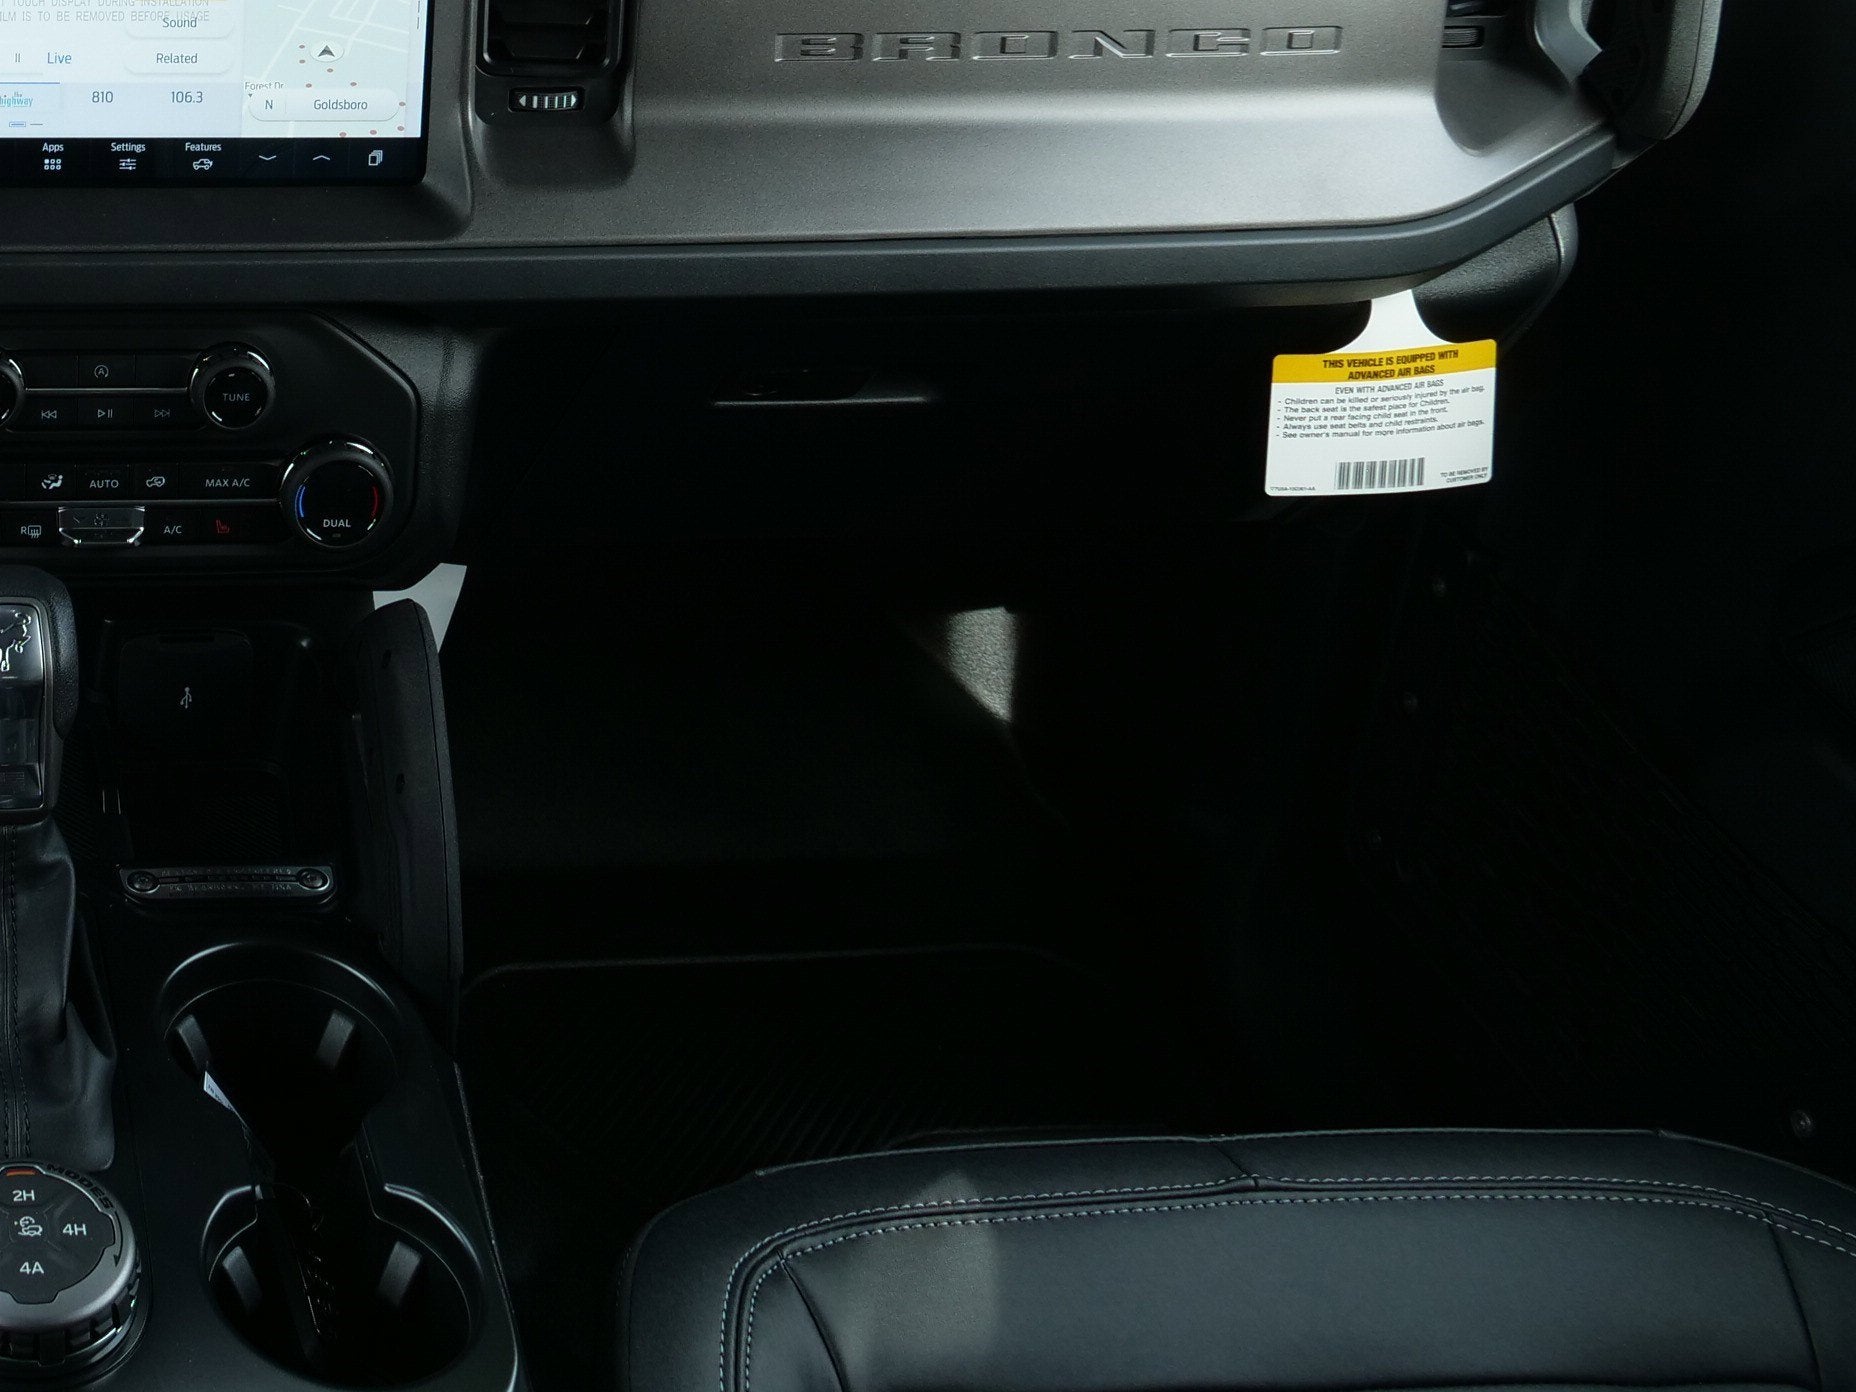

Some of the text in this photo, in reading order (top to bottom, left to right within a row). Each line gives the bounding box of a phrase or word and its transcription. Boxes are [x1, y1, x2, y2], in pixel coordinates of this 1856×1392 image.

[22, 10, 32, 22] IS
[38, 10, 51, 22] TO
[56, 10, 71, 22] BE
[75, 10, 125, 22] REMOVED
[130, 10, 170, 22] BEFORE
[162, 16, 198, 28] Sound
[773, 24, 1344, 63] BRONCO
[47, 52, 72, 64] Live
[155, 52, 198, 64] Related
[0, 94, 34, 108] highway
[92, 91, 114, 104] 810
[170, 91, 204, 104] 106.3
[265, 99, 274, 111] N
[313, 99, 368, 111] Goldsboro
[42, 142, 64, 154] Apps
[110, 142, 146, 154] Settings
[184, 142, 222, 152] Features
[1322, 349, 1459, 369] THIS VEHICLE IS EQUIPPED WITH
[1347, 364, 1436, 381] ADVANCED AIR BAGS
[1334, 379, 1445, 395] EVEN WITH ADVANCED AIR BAGS
[222, 393, 251, 402] TUNE
[89, 479, 119, 489] AUTO
[205, 477, 251, 488] MAX A/C
[322, 518, 352, 528] DUAL
[163, 524, 182, 535] A/C
[46, 1163, 115, 1210] MODES
[12, 1189, 36, 1202] 2H
[62, 1223, 87, 1237] 4H
[19, 1261, 45, 1275] 4A
